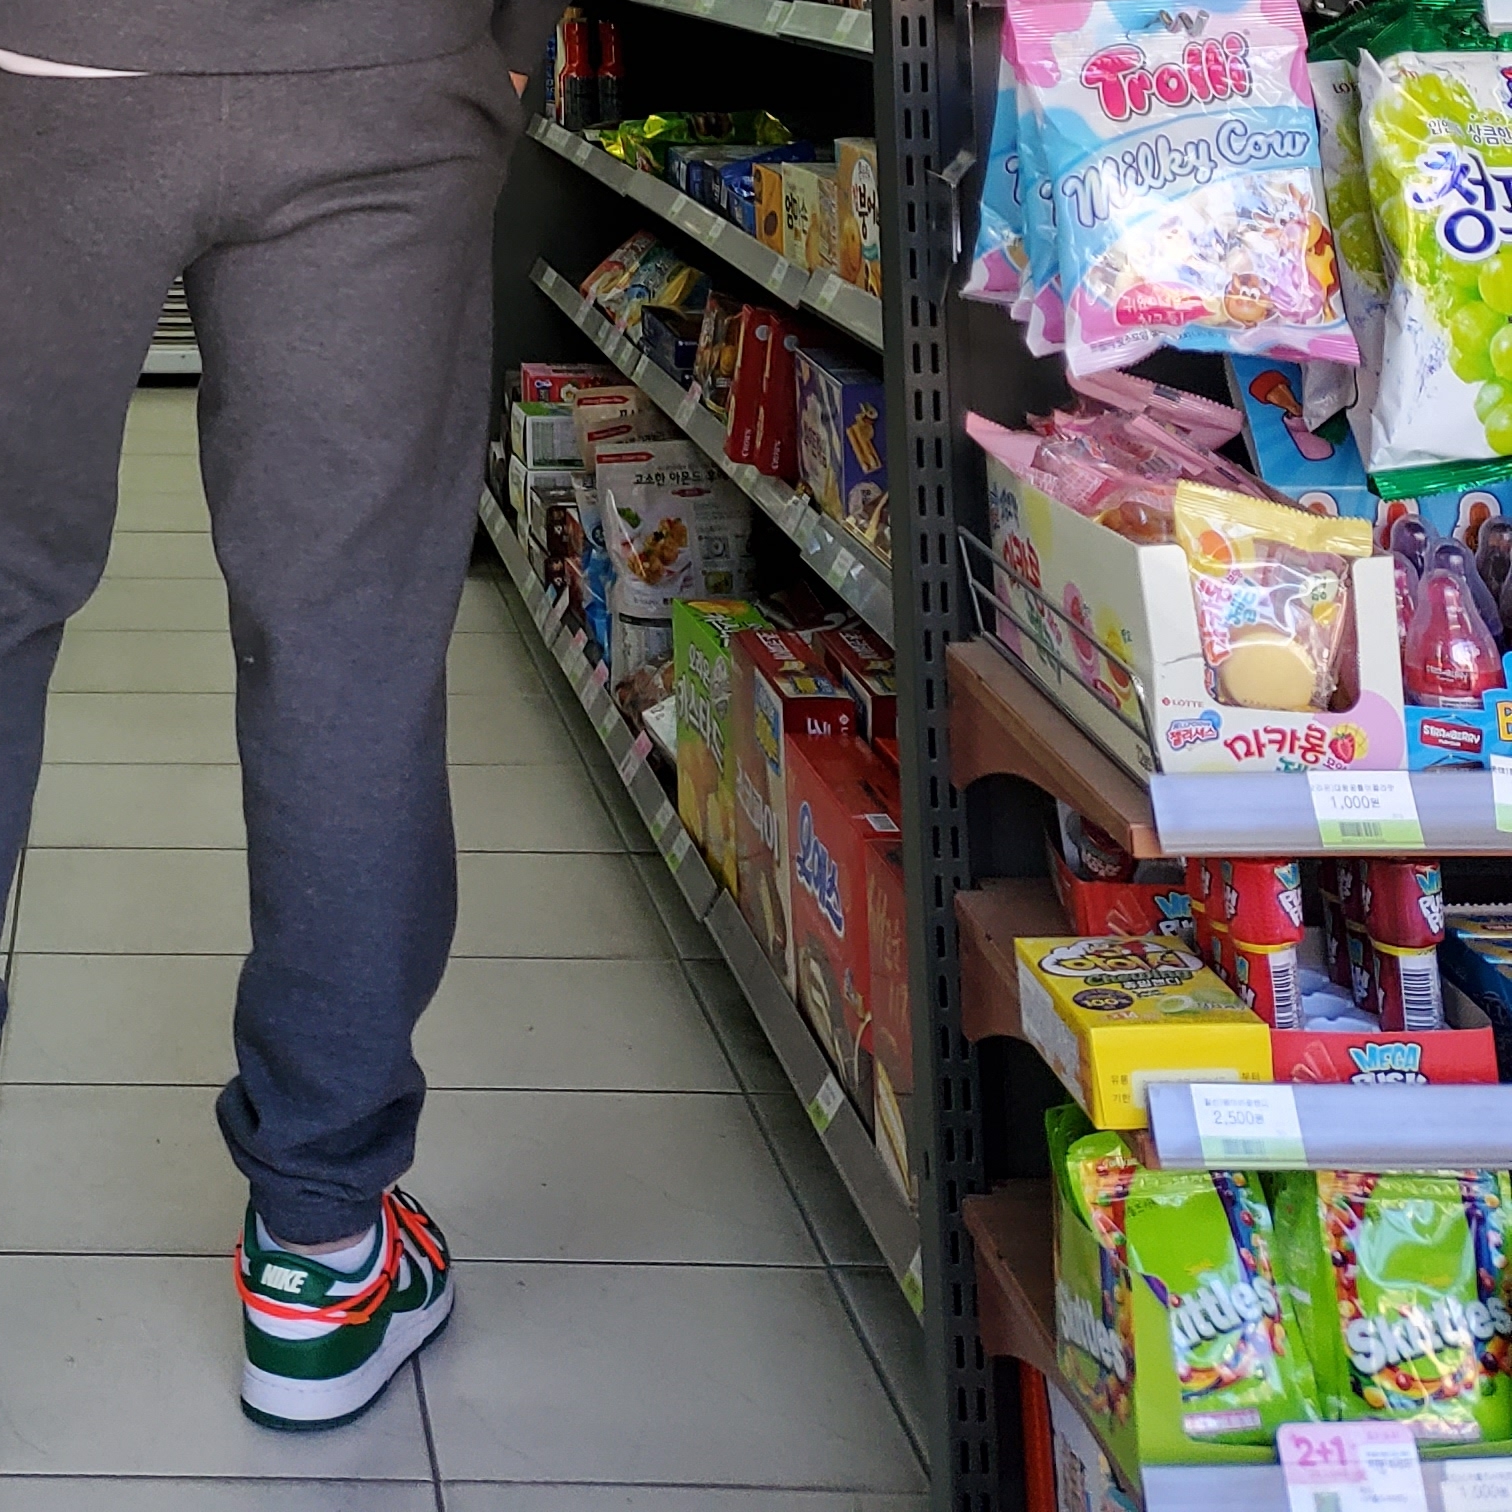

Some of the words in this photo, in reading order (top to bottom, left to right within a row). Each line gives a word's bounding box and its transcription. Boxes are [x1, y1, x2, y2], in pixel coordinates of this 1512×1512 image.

[1081, 31, 1254, 123] Trolli
[1062, 133, 1218, 229] Milky
[1215, 118, 1312, 165] Cow
[633, 472, 667, 486] 고소한
[669, 471, 703, 485] 아몬드
[1171, 698, 1205, 709] LOTTE
[1223, 724, 1328, 763] 마카롱
[1329, 794, 1381, 810] 1,000원
[1348, 1042, 1422, 1074] MEGA
[1110, 1073, 1129, 1086] 유통
[1111, 1092, 1131, 1105] 기한
[1213, 1109, 1265, 1127] 2,500원
[260, 1262, 309, 1295] NIKE
[1347, 1296, 1512, 1376] Skittles
[1293, 1440, 1349, 1467] 2+1
